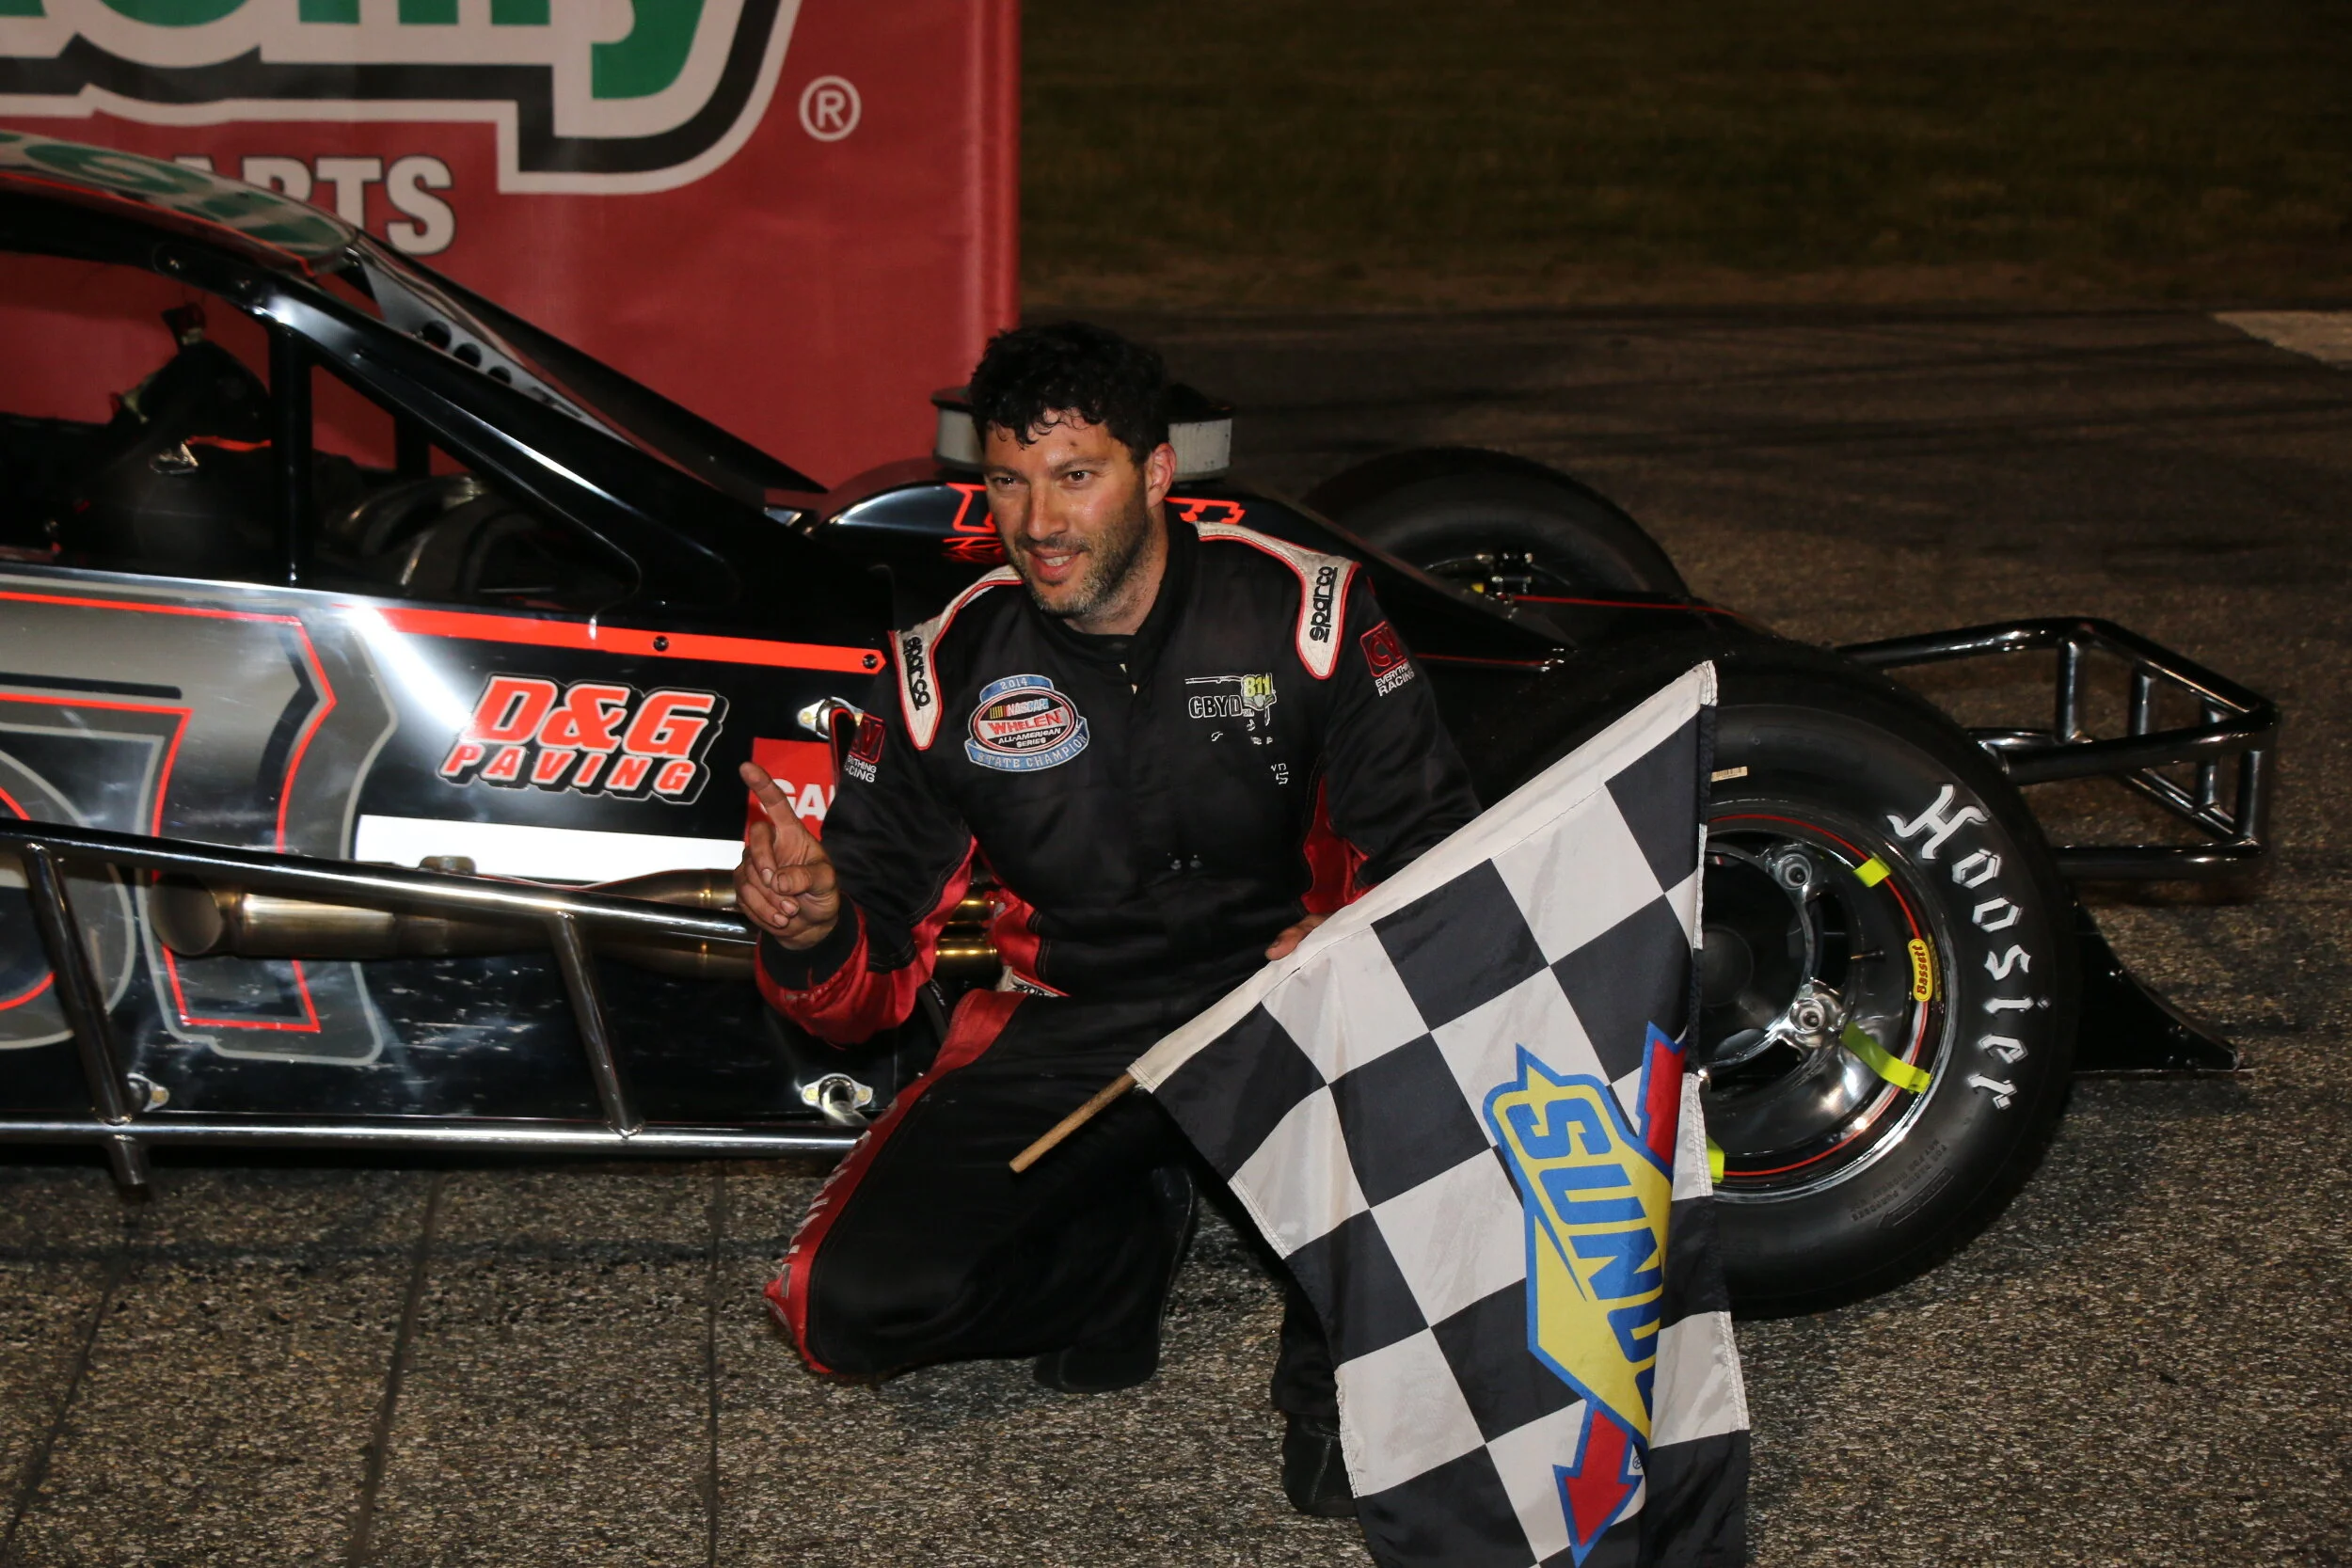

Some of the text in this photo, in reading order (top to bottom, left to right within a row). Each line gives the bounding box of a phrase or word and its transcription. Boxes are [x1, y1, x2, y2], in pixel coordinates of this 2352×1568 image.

[1310, 566, 1338, 642] sparco
[999, 677, 1028, 689] 2014
[461, 673, 717, 758] D&G
[988, 708, 1062, 736] WHELEN
[1006, 697, 1049, 716] NASCAR
[1188, 694, 1243, 719] CBYD
[977, 733, 1088, 768] STATE CHAMPION
[997, 727, 1061, 745] ALL-AMERICAN
[1016, 737, 1047, 749] SERIES
[440, 743, 697, 796] PAVING
[1886, 784, 2052, 1110] Hoosier
[1912, 944, 1929, 994] Bassett
